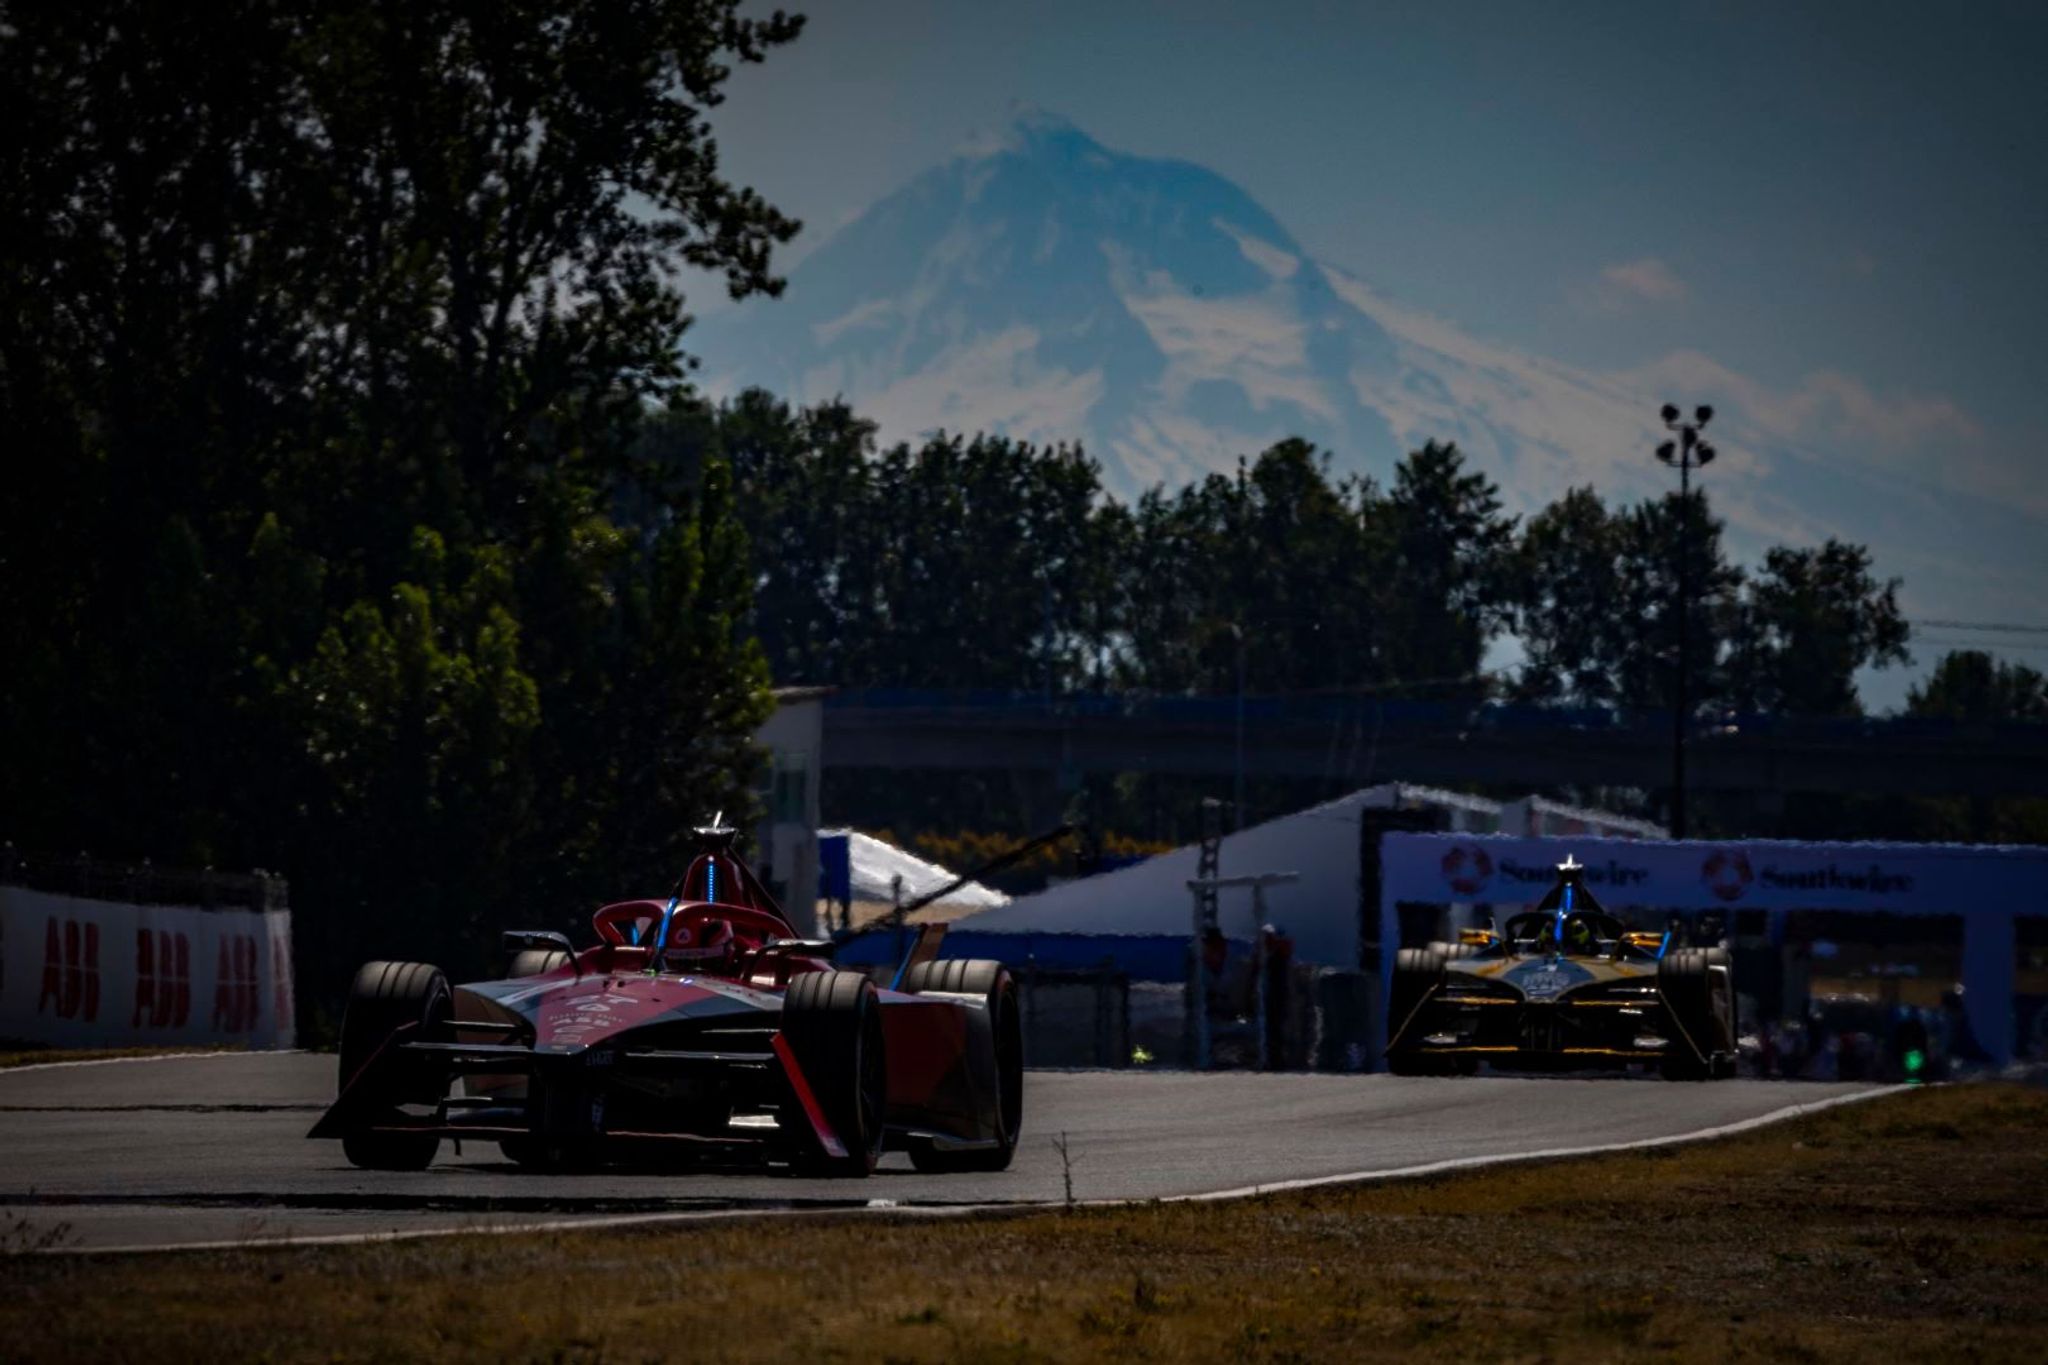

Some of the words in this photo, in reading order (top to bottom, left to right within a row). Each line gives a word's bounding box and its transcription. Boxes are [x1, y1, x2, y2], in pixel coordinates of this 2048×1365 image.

[1762, 863, 1913, 893] Southwire
[39, 916, 99, 1022] ABB
[133, 928, 190, 1028] ABB
[213, 932, 258, 1033] ABB
